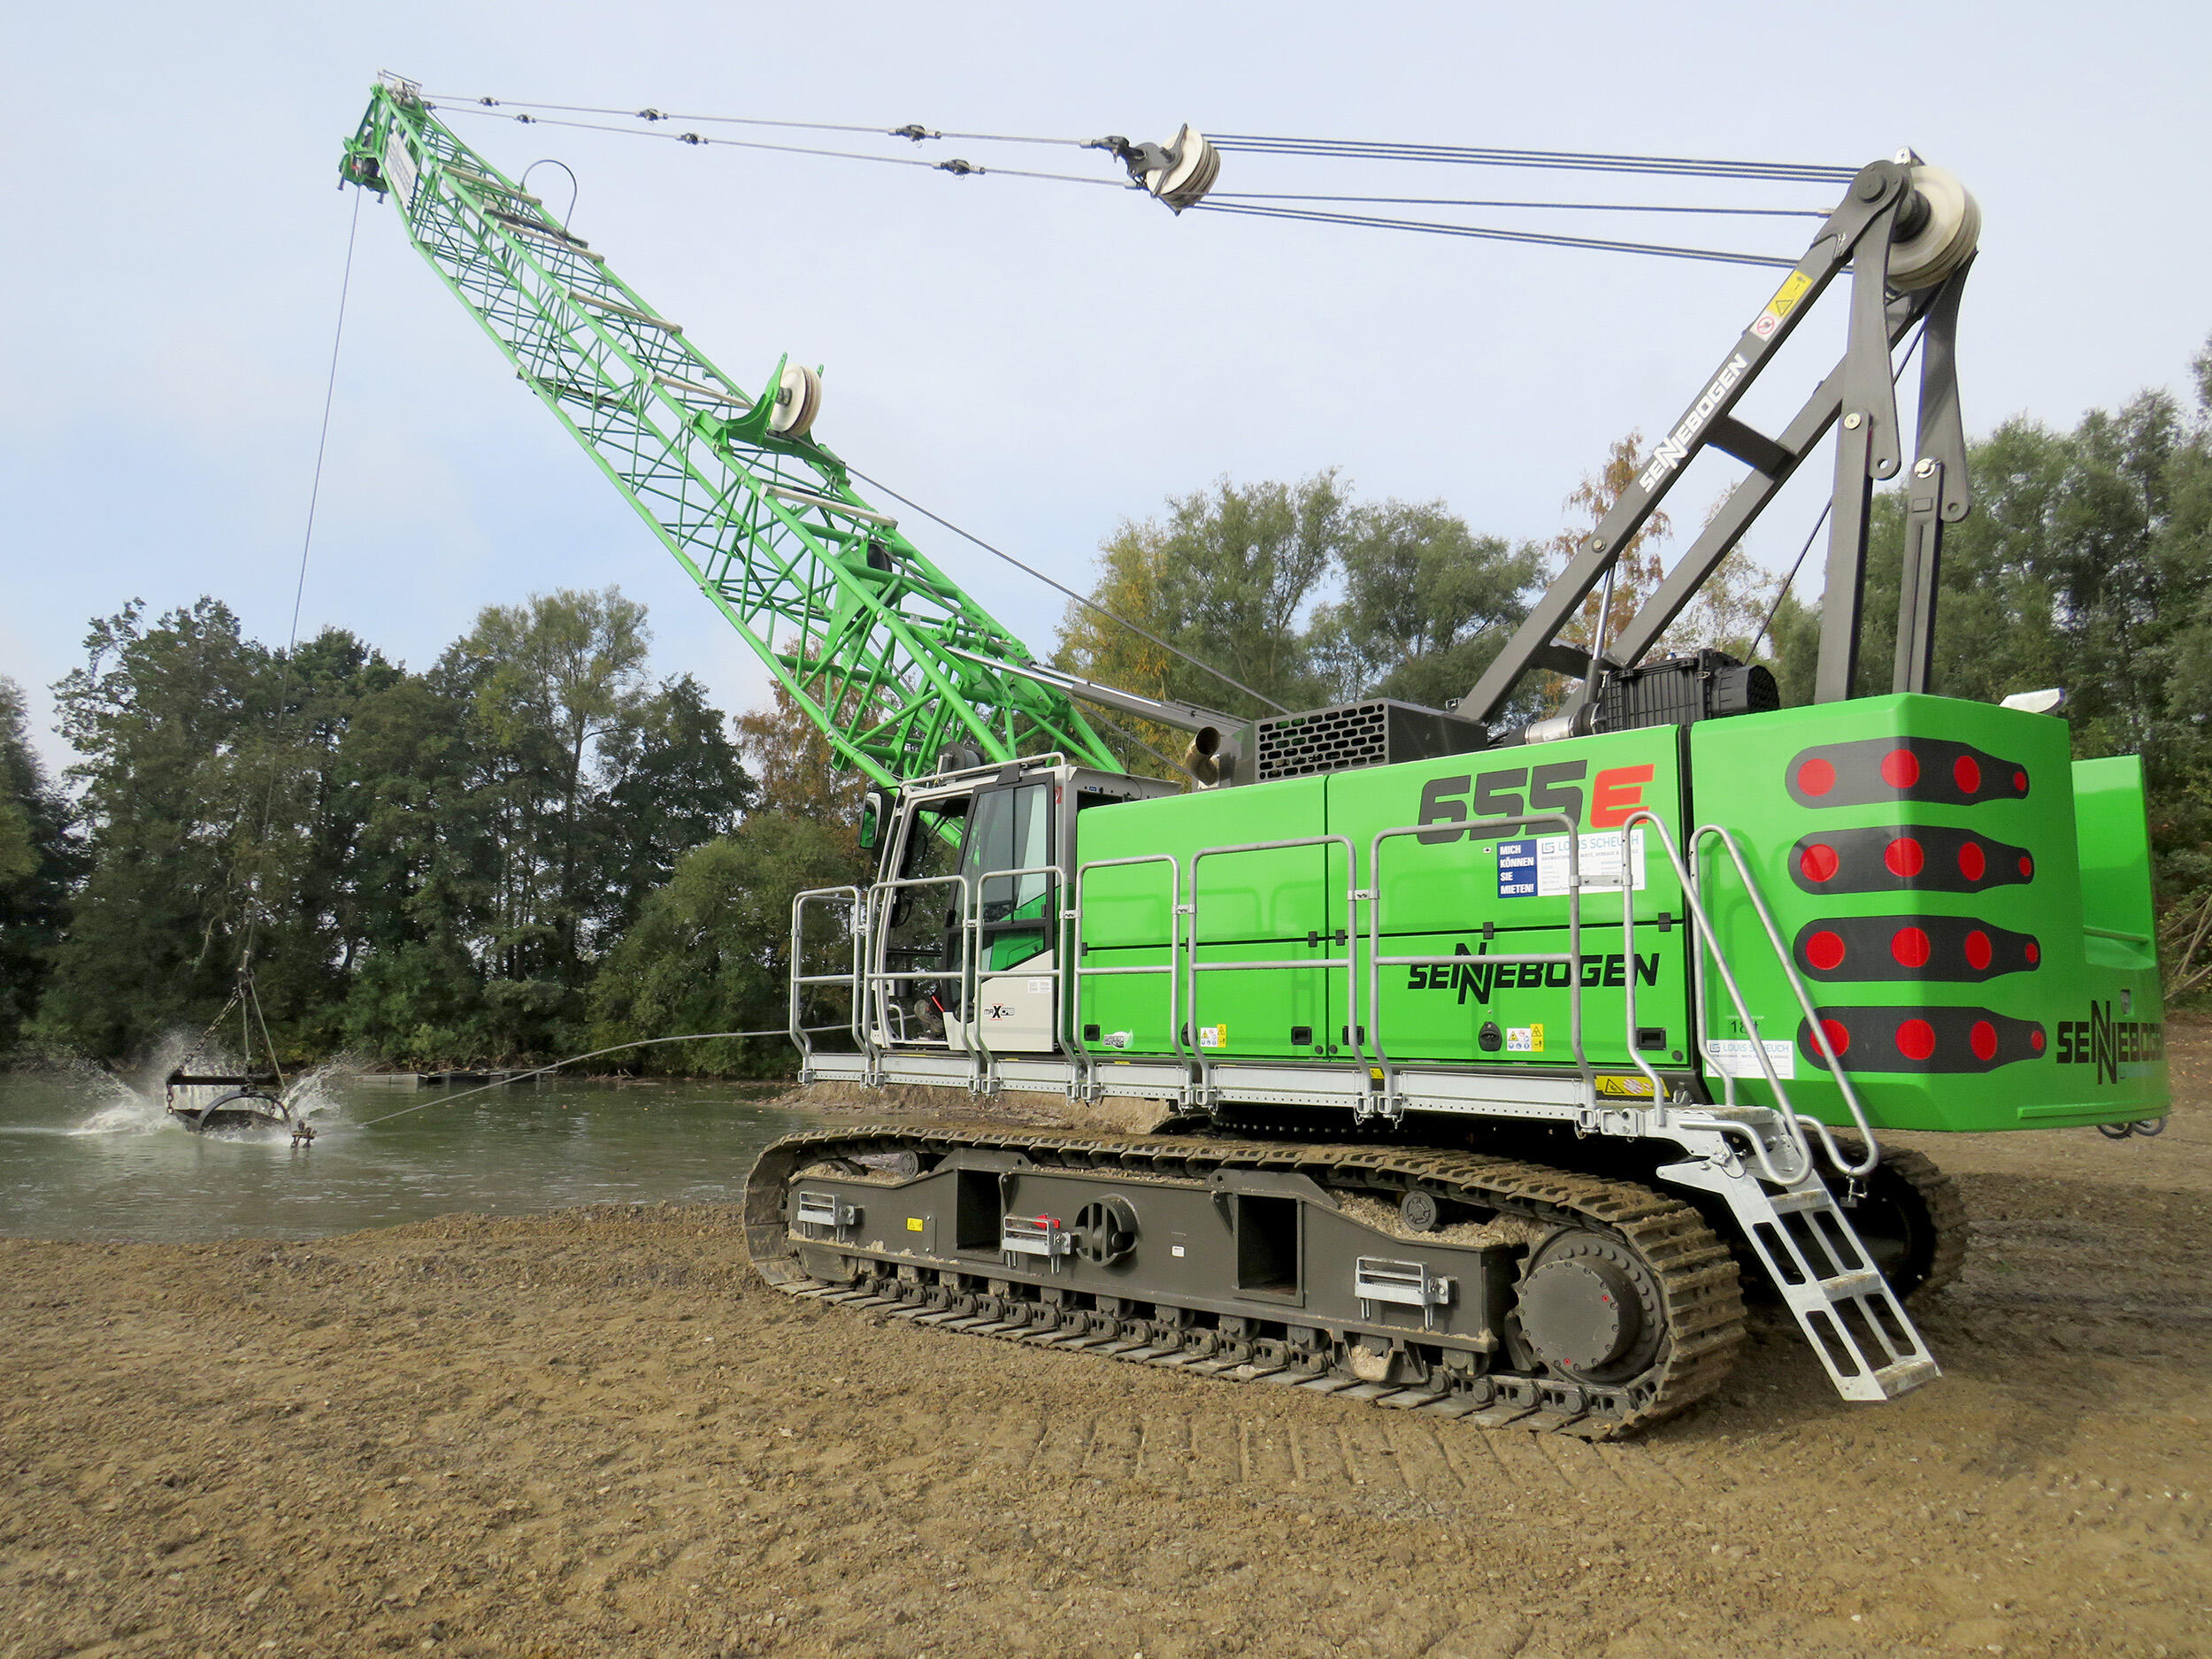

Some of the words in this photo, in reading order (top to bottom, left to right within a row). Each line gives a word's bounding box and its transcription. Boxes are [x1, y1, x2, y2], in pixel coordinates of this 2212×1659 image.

[1639, 353, 1747, 493] SENNEBOGEN
[1558, 838, 1587, 851] LOS
[1590, 835, 1639, 849] SCHEUH
[1500, 845, 1522, 856] MICH
[1500, 856, 1534, 869] KÖNNEN
[1500, 872, 1514, 881] SIE
[1500, 883, 1534, 895] MIETEN!
[1408, 942, 1660, 1005] SENNEBOGEN
[1723, 1043, 1747, 1052] LOUIS
[1749, 1044, 1789, 1053] SEUCH
